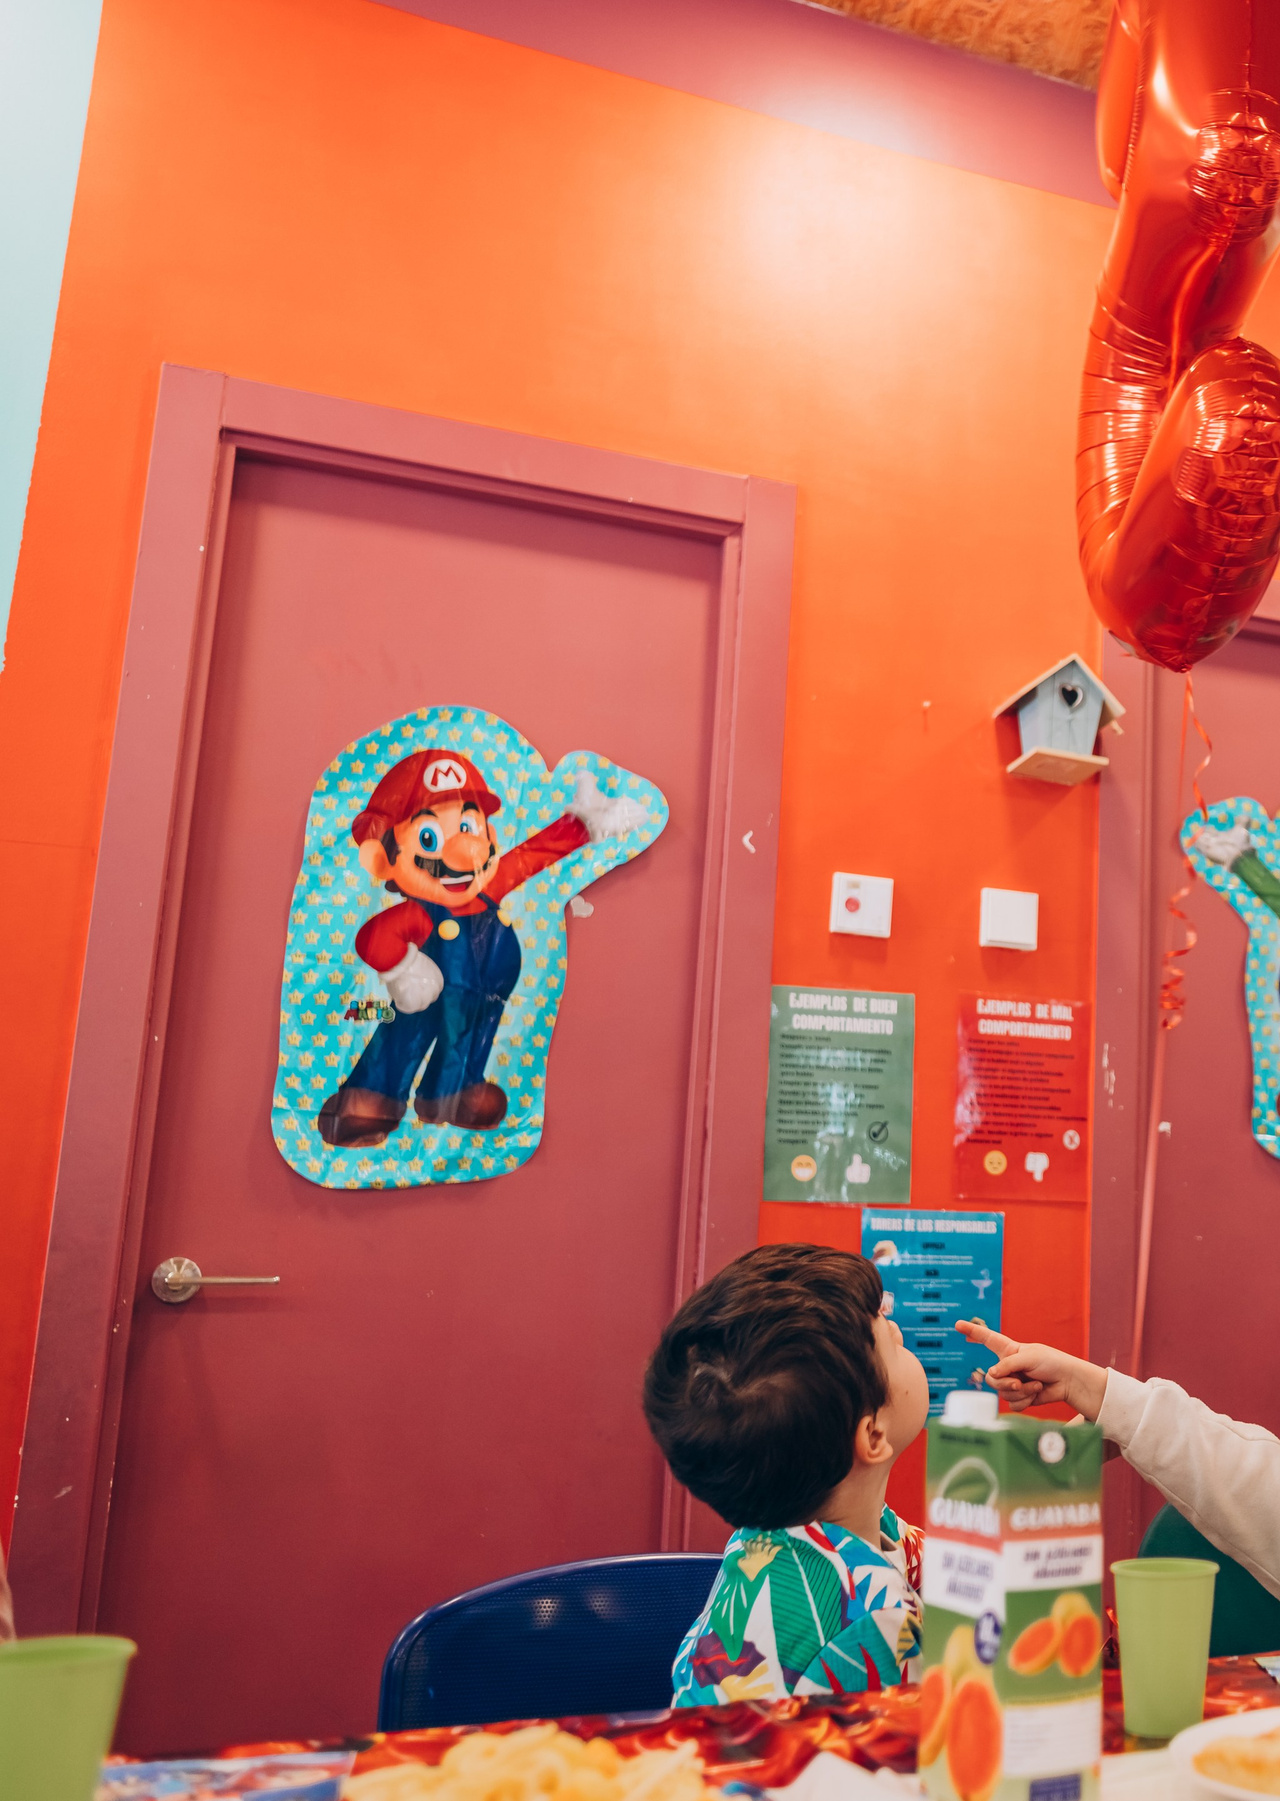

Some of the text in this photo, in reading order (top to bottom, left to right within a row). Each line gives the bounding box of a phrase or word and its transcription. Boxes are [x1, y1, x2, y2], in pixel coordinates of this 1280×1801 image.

[788, 992, 898, 1014] EJEMPLOS DE BUEN
[976, 998, 1074, 1021] EJEMPLOS DE MAL
[792, 1014, 893, 1035] COMPORTAMIENTO
[978, 1019, 1072, 1041] COMPORTAMIENTO
[870, 1217, 998, 1234] TAREAS DE LOS RESPONSABLES
[1010, 1501, 1100, 1531] GUAYABA
